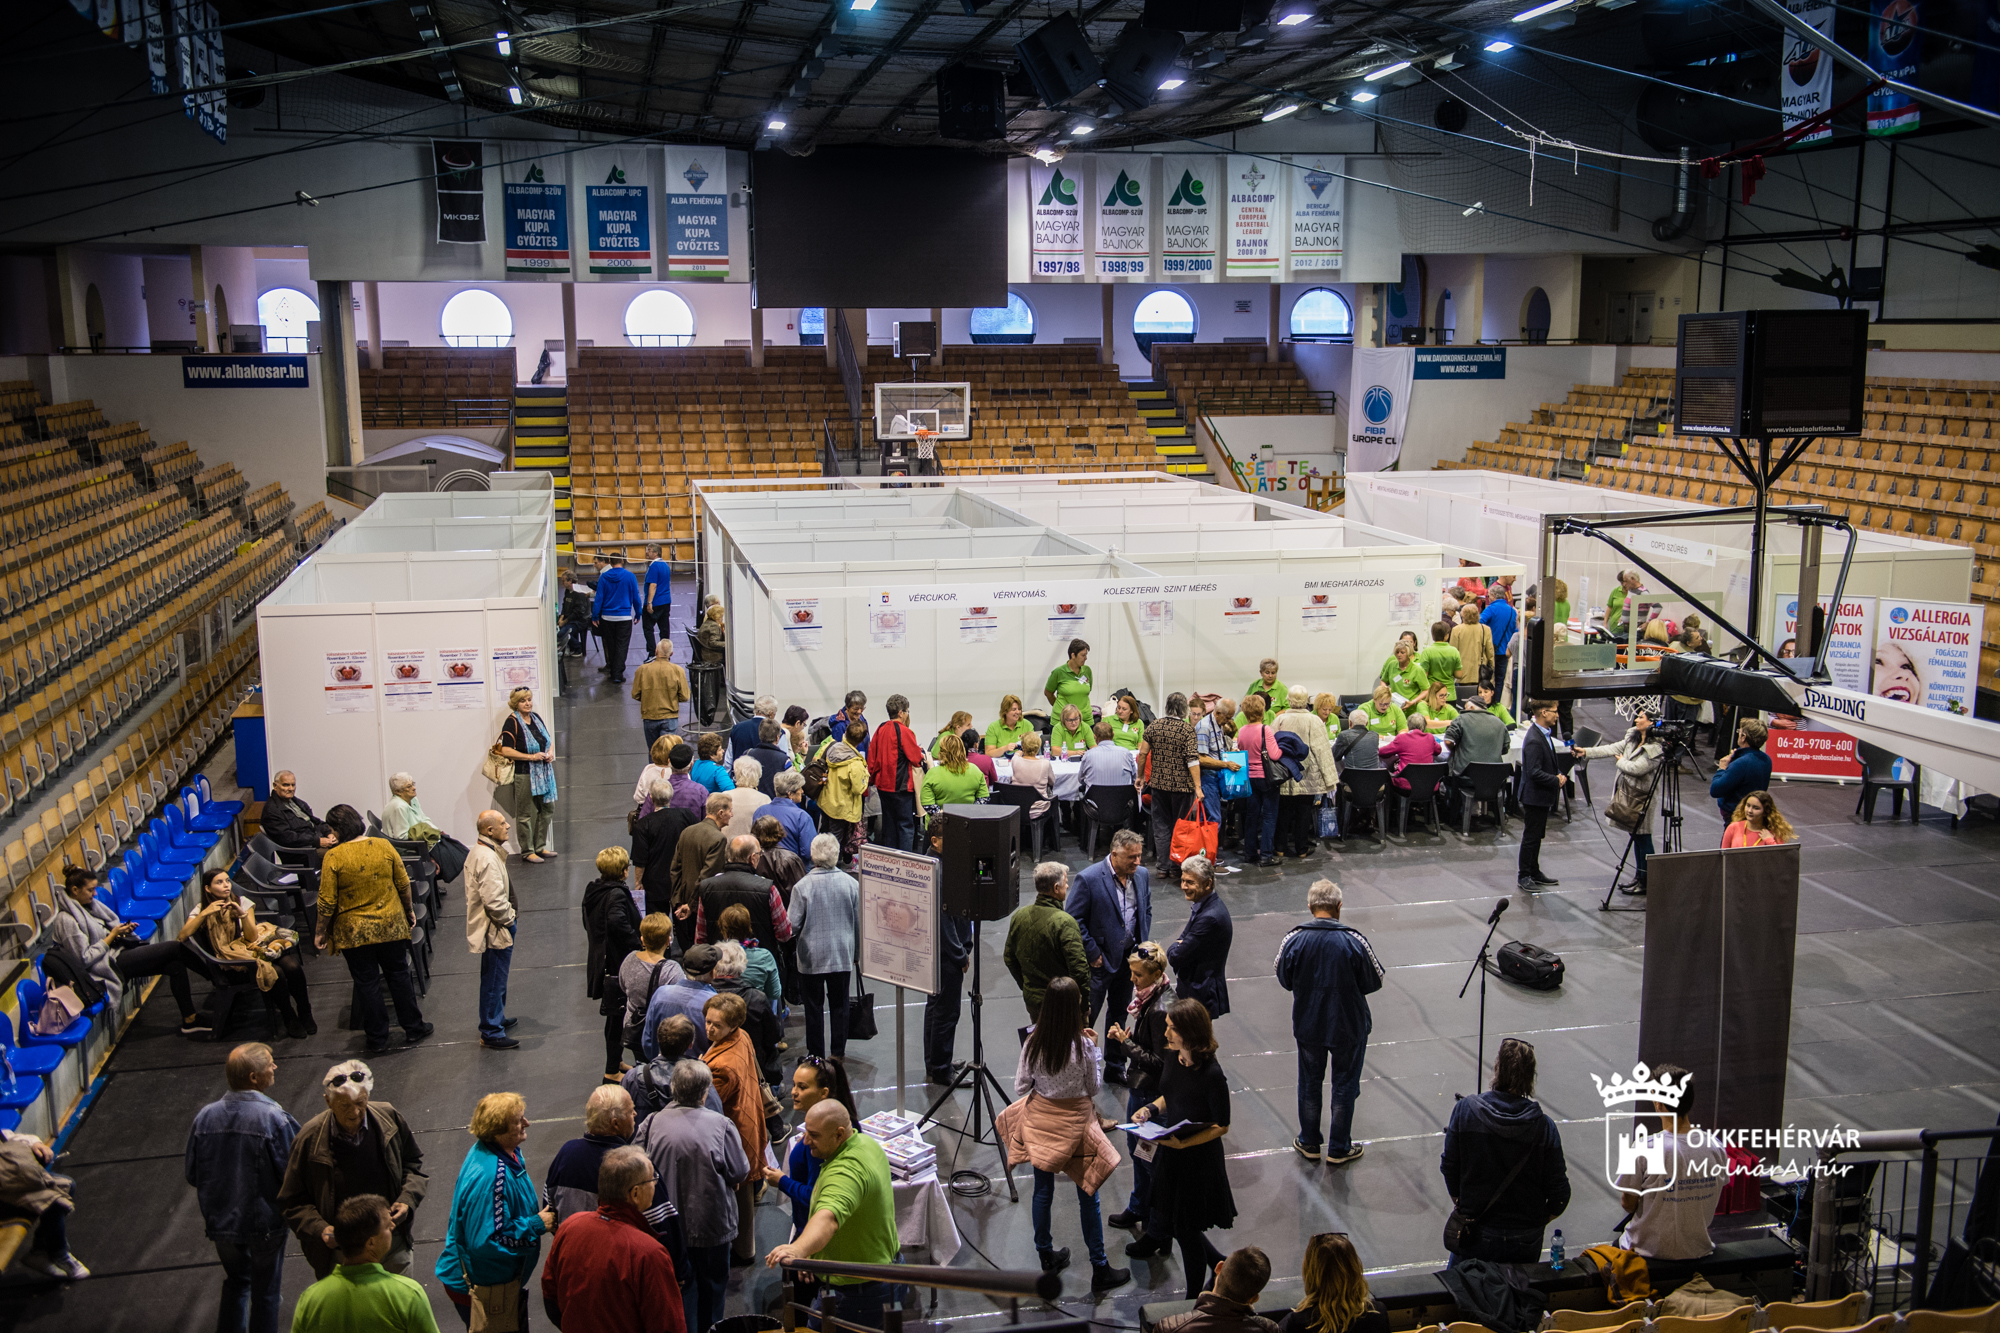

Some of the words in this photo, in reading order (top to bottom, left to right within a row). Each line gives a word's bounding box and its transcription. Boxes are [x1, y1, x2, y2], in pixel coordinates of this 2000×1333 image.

[592, 189, 642, 197] ALBACOMP-UPC
[1231, 194, 1275, 203] ALBACOMP
[671, 197, 688, 205] ALBA
[689, 196, 723, 205] FEHÉRVÁR
[517, 208, 556, 221] MAGYAR
[599, 210, 637, 222] MAGYAR
[1311, 209, 1340, 217] FEHÉRVÁR
[678, 215, 717, 225] MAGYAR
[525, 222, 550, 233] KUPA
[606, 223, 632, 234] KUPA
[1035, 221, 1080, 232] MAGYAR
[1102, 226, 1145, 237] MAGYAR
[1166, 226, 1210, 236] MAGYAR
[1295, 222, 1340, 233] MAGYAR
[685, 228, 711, 238] KUPA
[517, 233, 558, 247] GYŐZTES
[599, 235, 640, 248] GYŐZTES
[1036, 234, 1079, 244] BAJNOK
[1103, 239, 1144, 250] BAJNOK
[1167, 238, 1208, 248] BAJNOK
[1236, 239, 1269, 248] BAJNOK
[1295, 236, 1339, 247] BAJNOK
[676, 239, 720, 251] GYŐZTES
[1038, 261, 1080, 274] 1997/98
[1102, 261, 1144, 274] 1998/99
[1164, 259, 1212, 272] 1999/2000
[1417, 354, 1502, 363] WWW.DAVIDKORNELAKADEMIA.HU
[188, 364, 305, 379] www.albakosar.hu
[1440, 365, 1478, 374] WWW.ARSC.HU
[1365, 426, 1386, 435] FIBA
[1682, 425, 1731, 433] www.visualsolutions.hu
[1766, 425, 1846, 434] www.visualsolutions.hu
[1234, 460, 1309, 477] CSEMETE
[1651, 541, 1666, 550] COPD
[908, 593, 958, 602] VÉRCUKOR,
[993, 589, 1048, 599] VÉRNYOMÁS,
[1103, 586, 1160, 596] KOLESZTERIN
[1163, 584, 1187, 594] SZINT
[1188, 582, 1217, 592] MÉRÉS
[1304, 581, 1318, 589] BMI
[1319, 578, 1385, 589] MEGHATÁROZÁS
[1911, 609, 1971, 627] ALLERGIA
[1889, 626, 1970, 646] VIZSGÁLATOK
[1830, 640, 1862, 650] OLERANCIA
[1830, 650, 1861, 659] VIZSGÁLAT
[1935, 648, 1969, 659] FOGÁSZATI
[1928, 657, 1967, 669] FÉMALLERGIA
[1942, 669, 1966, 679] PRÓBÁK
[1929, 682, 1965, 693] KÖRNYEZETI
[1804, 688, 1866, 721] SPALDING
[1777, 737, 1853, 751] 06-20-9708-600
[1777, 752, 1852, 762] www.allergia-szoboszlaine.hu
